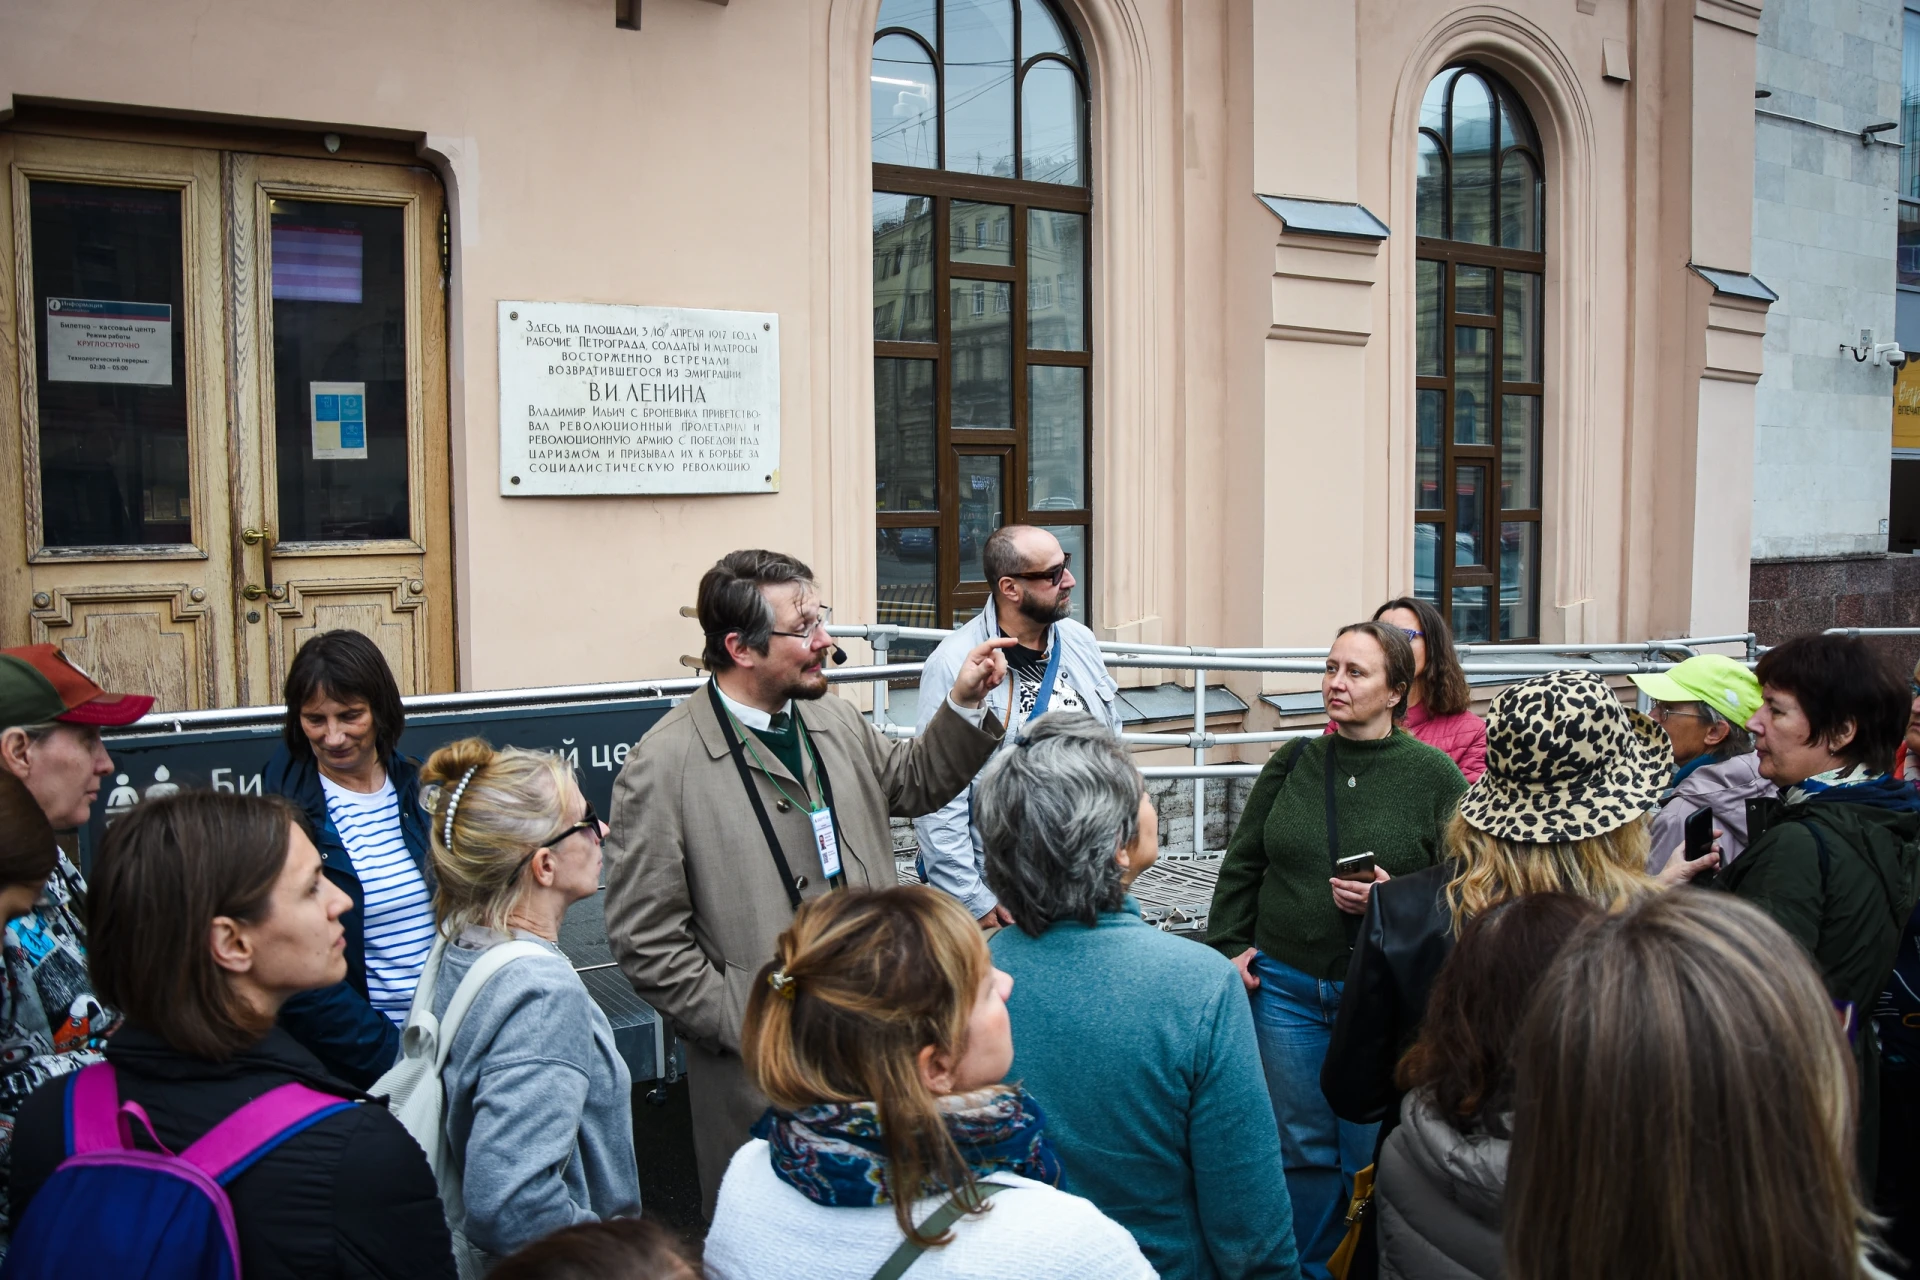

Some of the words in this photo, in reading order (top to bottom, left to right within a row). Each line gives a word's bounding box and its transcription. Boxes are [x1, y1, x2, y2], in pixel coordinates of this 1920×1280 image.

[60, 321, 91, 331] Билетно
[99, 324, 134, 332] кассовый
[134, 326, 156, 334] центр
[565, 324, 580, 334] НА
[584, 325, 639, 337] ПЛОЩАДИ,
[641, 326, 648, 337] 3
[670, 328, 704, 338] АПРЕЛЯ
[708, 329, 727, 340] 1917
[732, 330, 758, 341] ГОДА
[108, 333, 131, 341] работы
[77, 340, 140, 350] КРУГЛОСУТОЧНО
[526, 336, 572, 348] РАБОЧИЕ
[652, 341, 700, 352] СОЛДАТЫ
[704, 342, 711, 352] И
[713, 343, 758, 354] МАТРОСЫ
[68, 354, 121, 363] Технологический
[561, 351, 653, 364] ВОСТОРЖЕННО
[664, 354, 730, 366] ВСТРЕЧАЛИ
[548, 365, 662, 378] ВОЗВРАТИВШЕГОСЯ
[666, 367, 679, 378] ИЗ
[684, 368, 742, 380] ЭМИГРАЦИИ
[626, 382, 707, 403] ЛЕНИНА
[630, 407, 638, 418] С
[643, 407, 698, 419] БРОНЕВИКА
[528, 421, 550, 432] ВАЛ
[560, 419, 672, 432] РЕВОЛЮЦИОННЫЙ
[753, 423, 760, 432] И
[529, 434, 631, 446] РЕВОЛЮЦИОННУЮ
[636, 435, 674, 446] АРМИЮ
[678, 434, 686, 446] С
[740, 436, 760, 446] НАД
[529, 448, 600, 460] ЦАРИЗМОМ
[607, 449, 615, 459] И
[620, 448, 675, 459] ПРИЗЫВАЛ
[680, 449, 693, 459] ИХ
[698, 449, 705, 459] К
[709, 449, 744, 459] БОРЬБЕ
[748, 448, 760, 459] ЗА
[529, 462, 675, 473] СОЦИАЛИСТИЧЕСКУЮ
[591, 742, 638, 772] це
